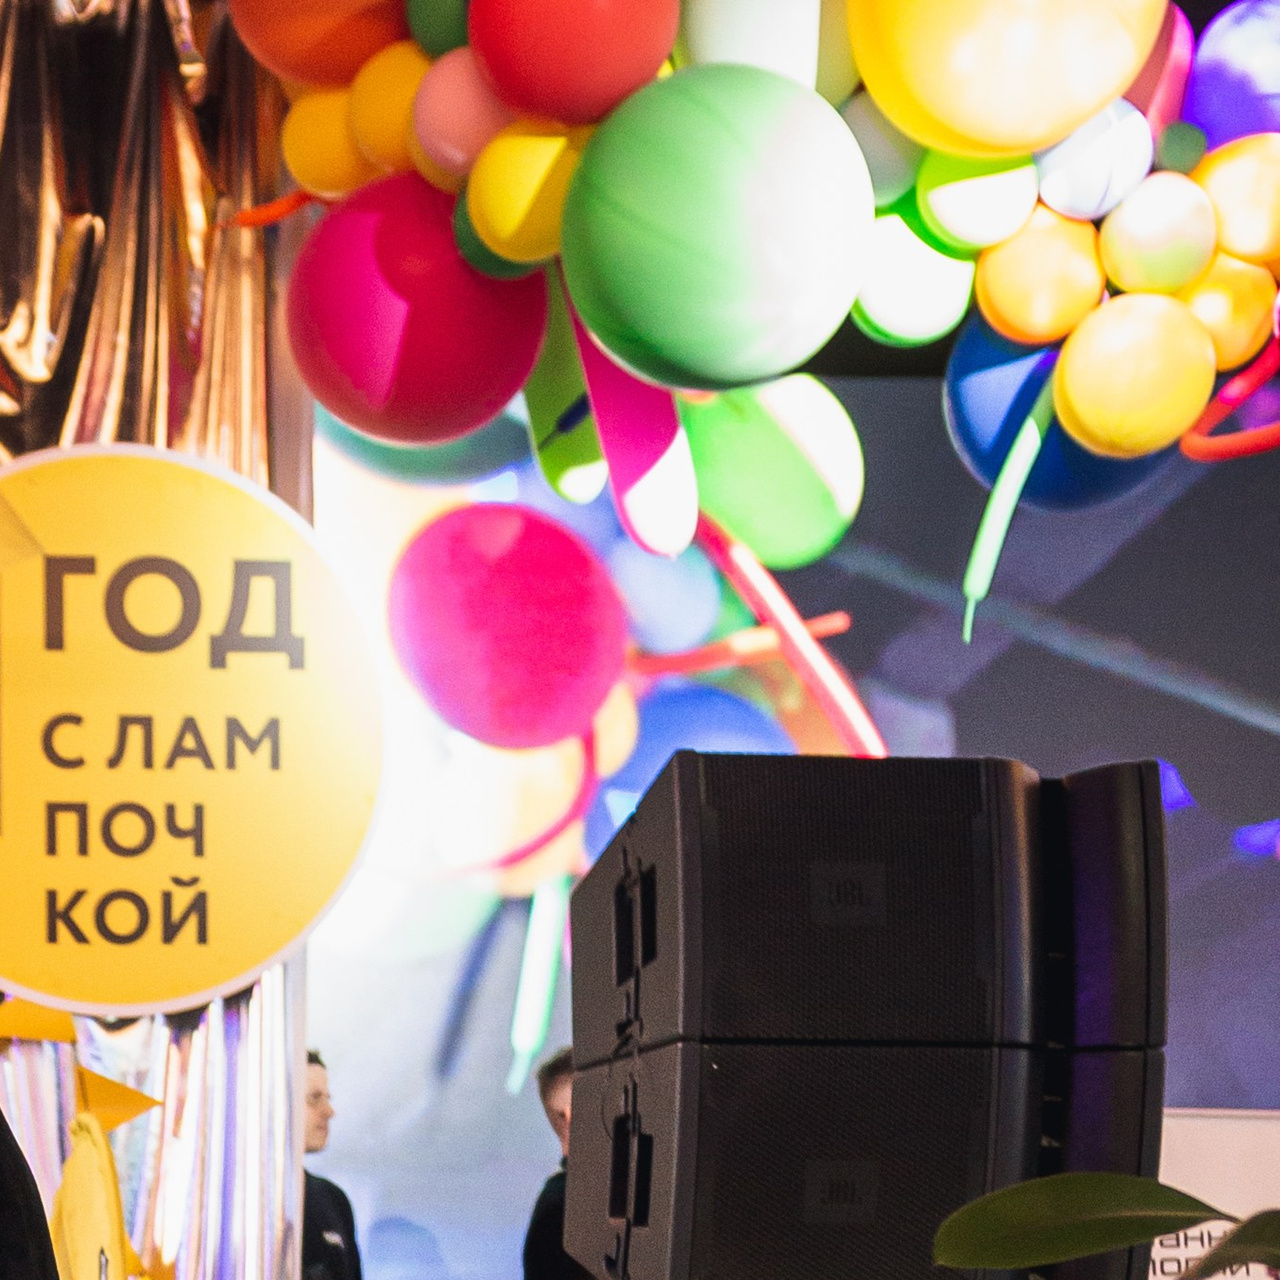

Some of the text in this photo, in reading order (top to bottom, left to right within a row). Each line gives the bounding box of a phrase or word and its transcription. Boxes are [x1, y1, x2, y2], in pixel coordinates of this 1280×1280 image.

[44, 555, 305, 670] ГОД
[41, 713, 281, 770] С ЛАМ
[46, 802, 205, 857] ПОЧ
[46, 876, 209, 945] КОЙ
